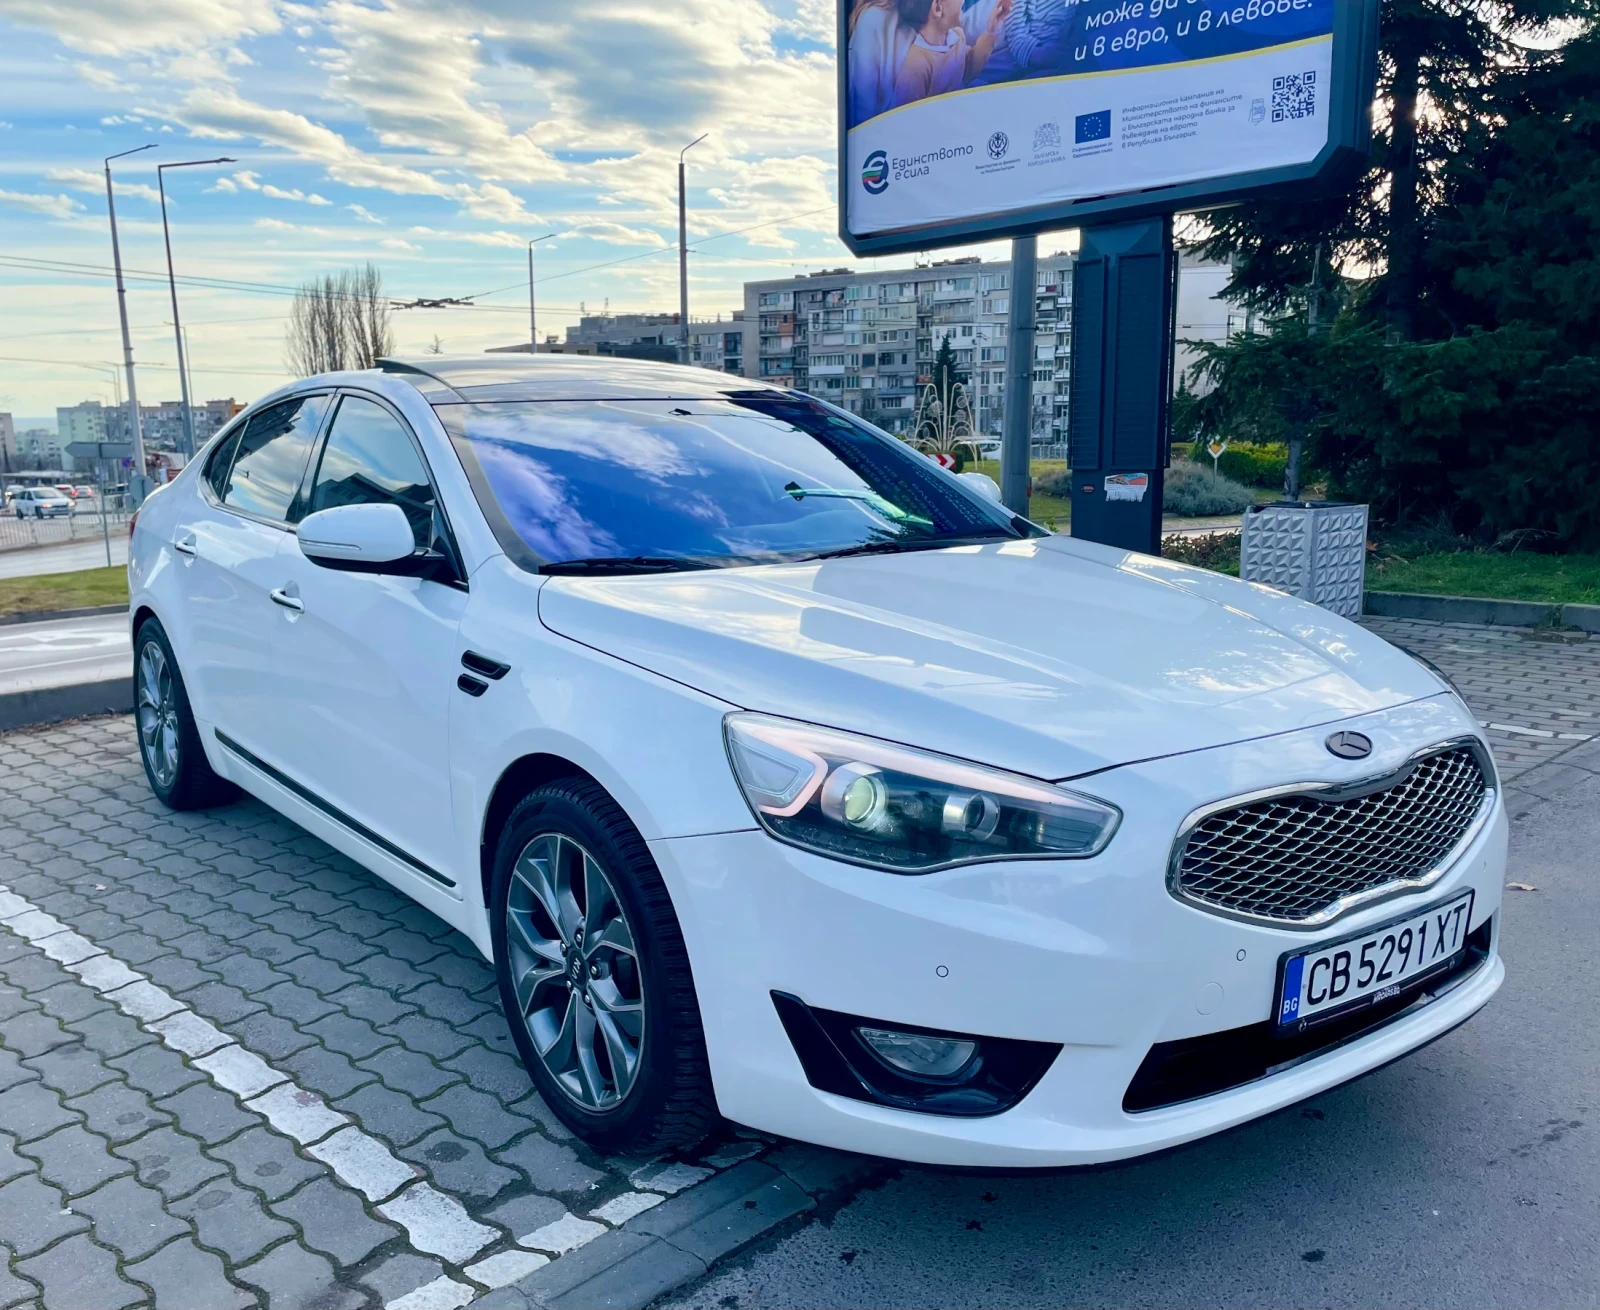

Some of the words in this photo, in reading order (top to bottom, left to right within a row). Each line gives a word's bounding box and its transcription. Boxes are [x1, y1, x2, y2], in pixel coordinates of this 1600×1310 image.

[1085, 1, 1144, 30] може
[1074, 45, 1086, 61] и
[1093, 36, 1105, 57] в
[1111, 26, 1169, 51] евро,
[1177, 20, 1190, 37] и
[1197, 9, 1212, 31] в
[1216, 0, 1313, 28] левове.
[1122, 98, 1179, 114] Информационна
[1179, 90, 1214, 103] кампания
[1122, 105, 1188, 122] Министерството
[1199, 94, 1243, 108] финансите
[1121, 128, 1158, 141] въвеждане
[1169, 121, 1198, 132] еврото
[1127, 117, 1172, 131] Българската
[1173, 112, 1204, 123] народна
[1205, 106, 1226, 116] банка
[1227, 105, 1236, 113] за
[1127, 137, 1162, 148] Република
[892, 145, 974, 171] Единството
[894, 172, 902, 181] е
[904, 166, 930, 180] сила
[1306, 950, 1351, 1006] CB
[1357, 920, 1428, 989] 5291
[1431, 902, 1467, 960] XT
[1283, 996, 1298, 1015] BG
